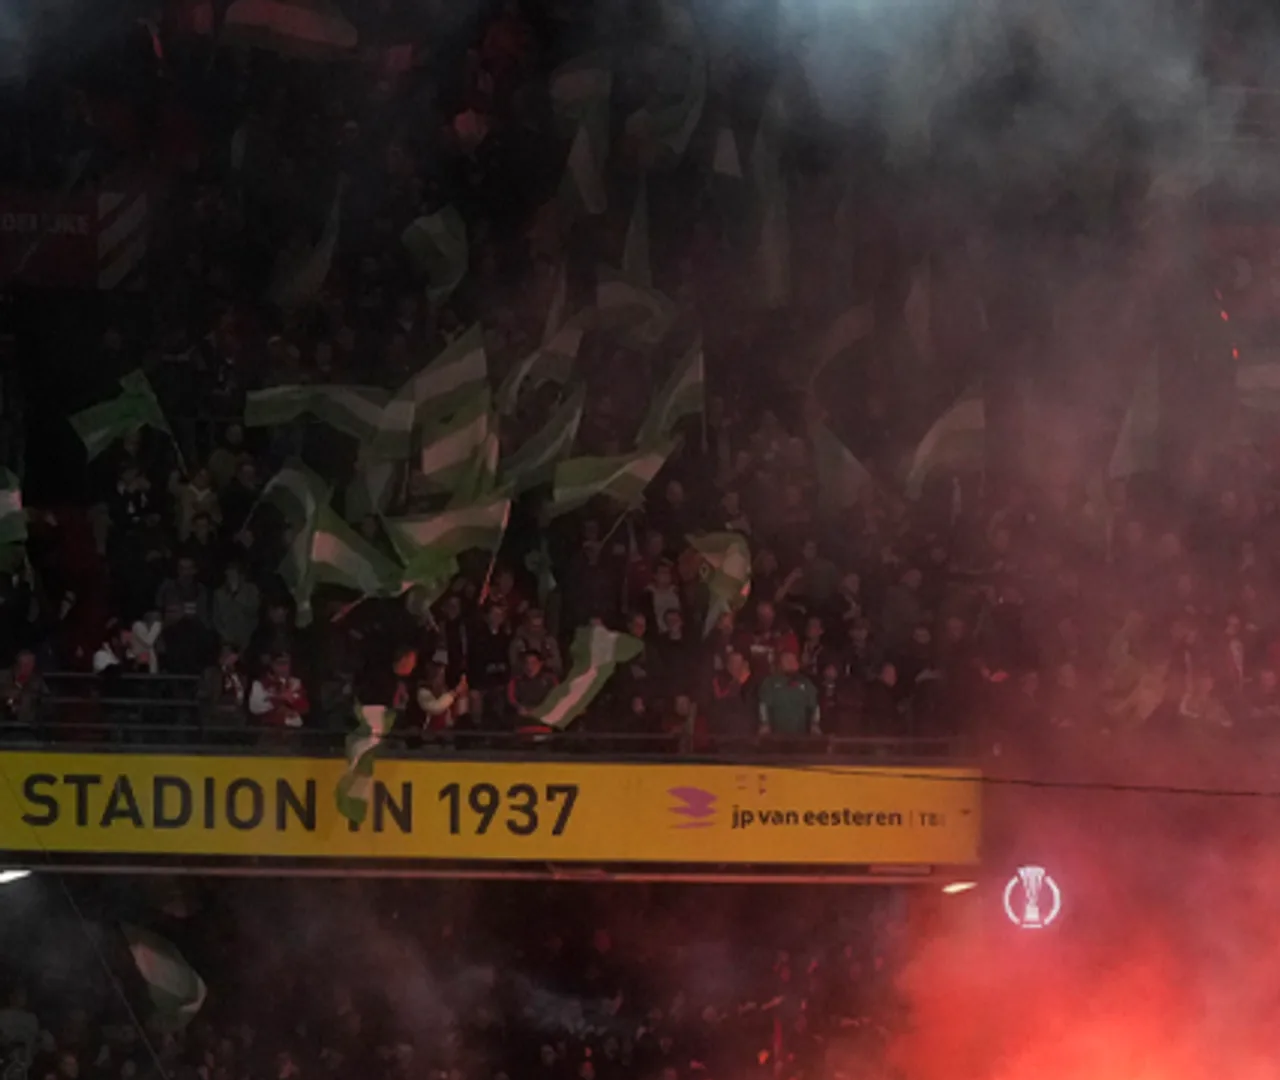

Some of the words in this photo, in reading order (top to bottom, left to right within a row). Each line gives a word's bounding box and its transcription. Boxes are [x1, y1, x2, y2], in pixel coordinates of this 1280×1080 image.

[21, 772, 316, 832] STADION
[347, 779, 412, 834] N
[438, 782, 579, 836] 1937
[731, 806, 754, 829] jp
[758, 810, 798, 827] van
[802, 807, 902, 827] eesteren
